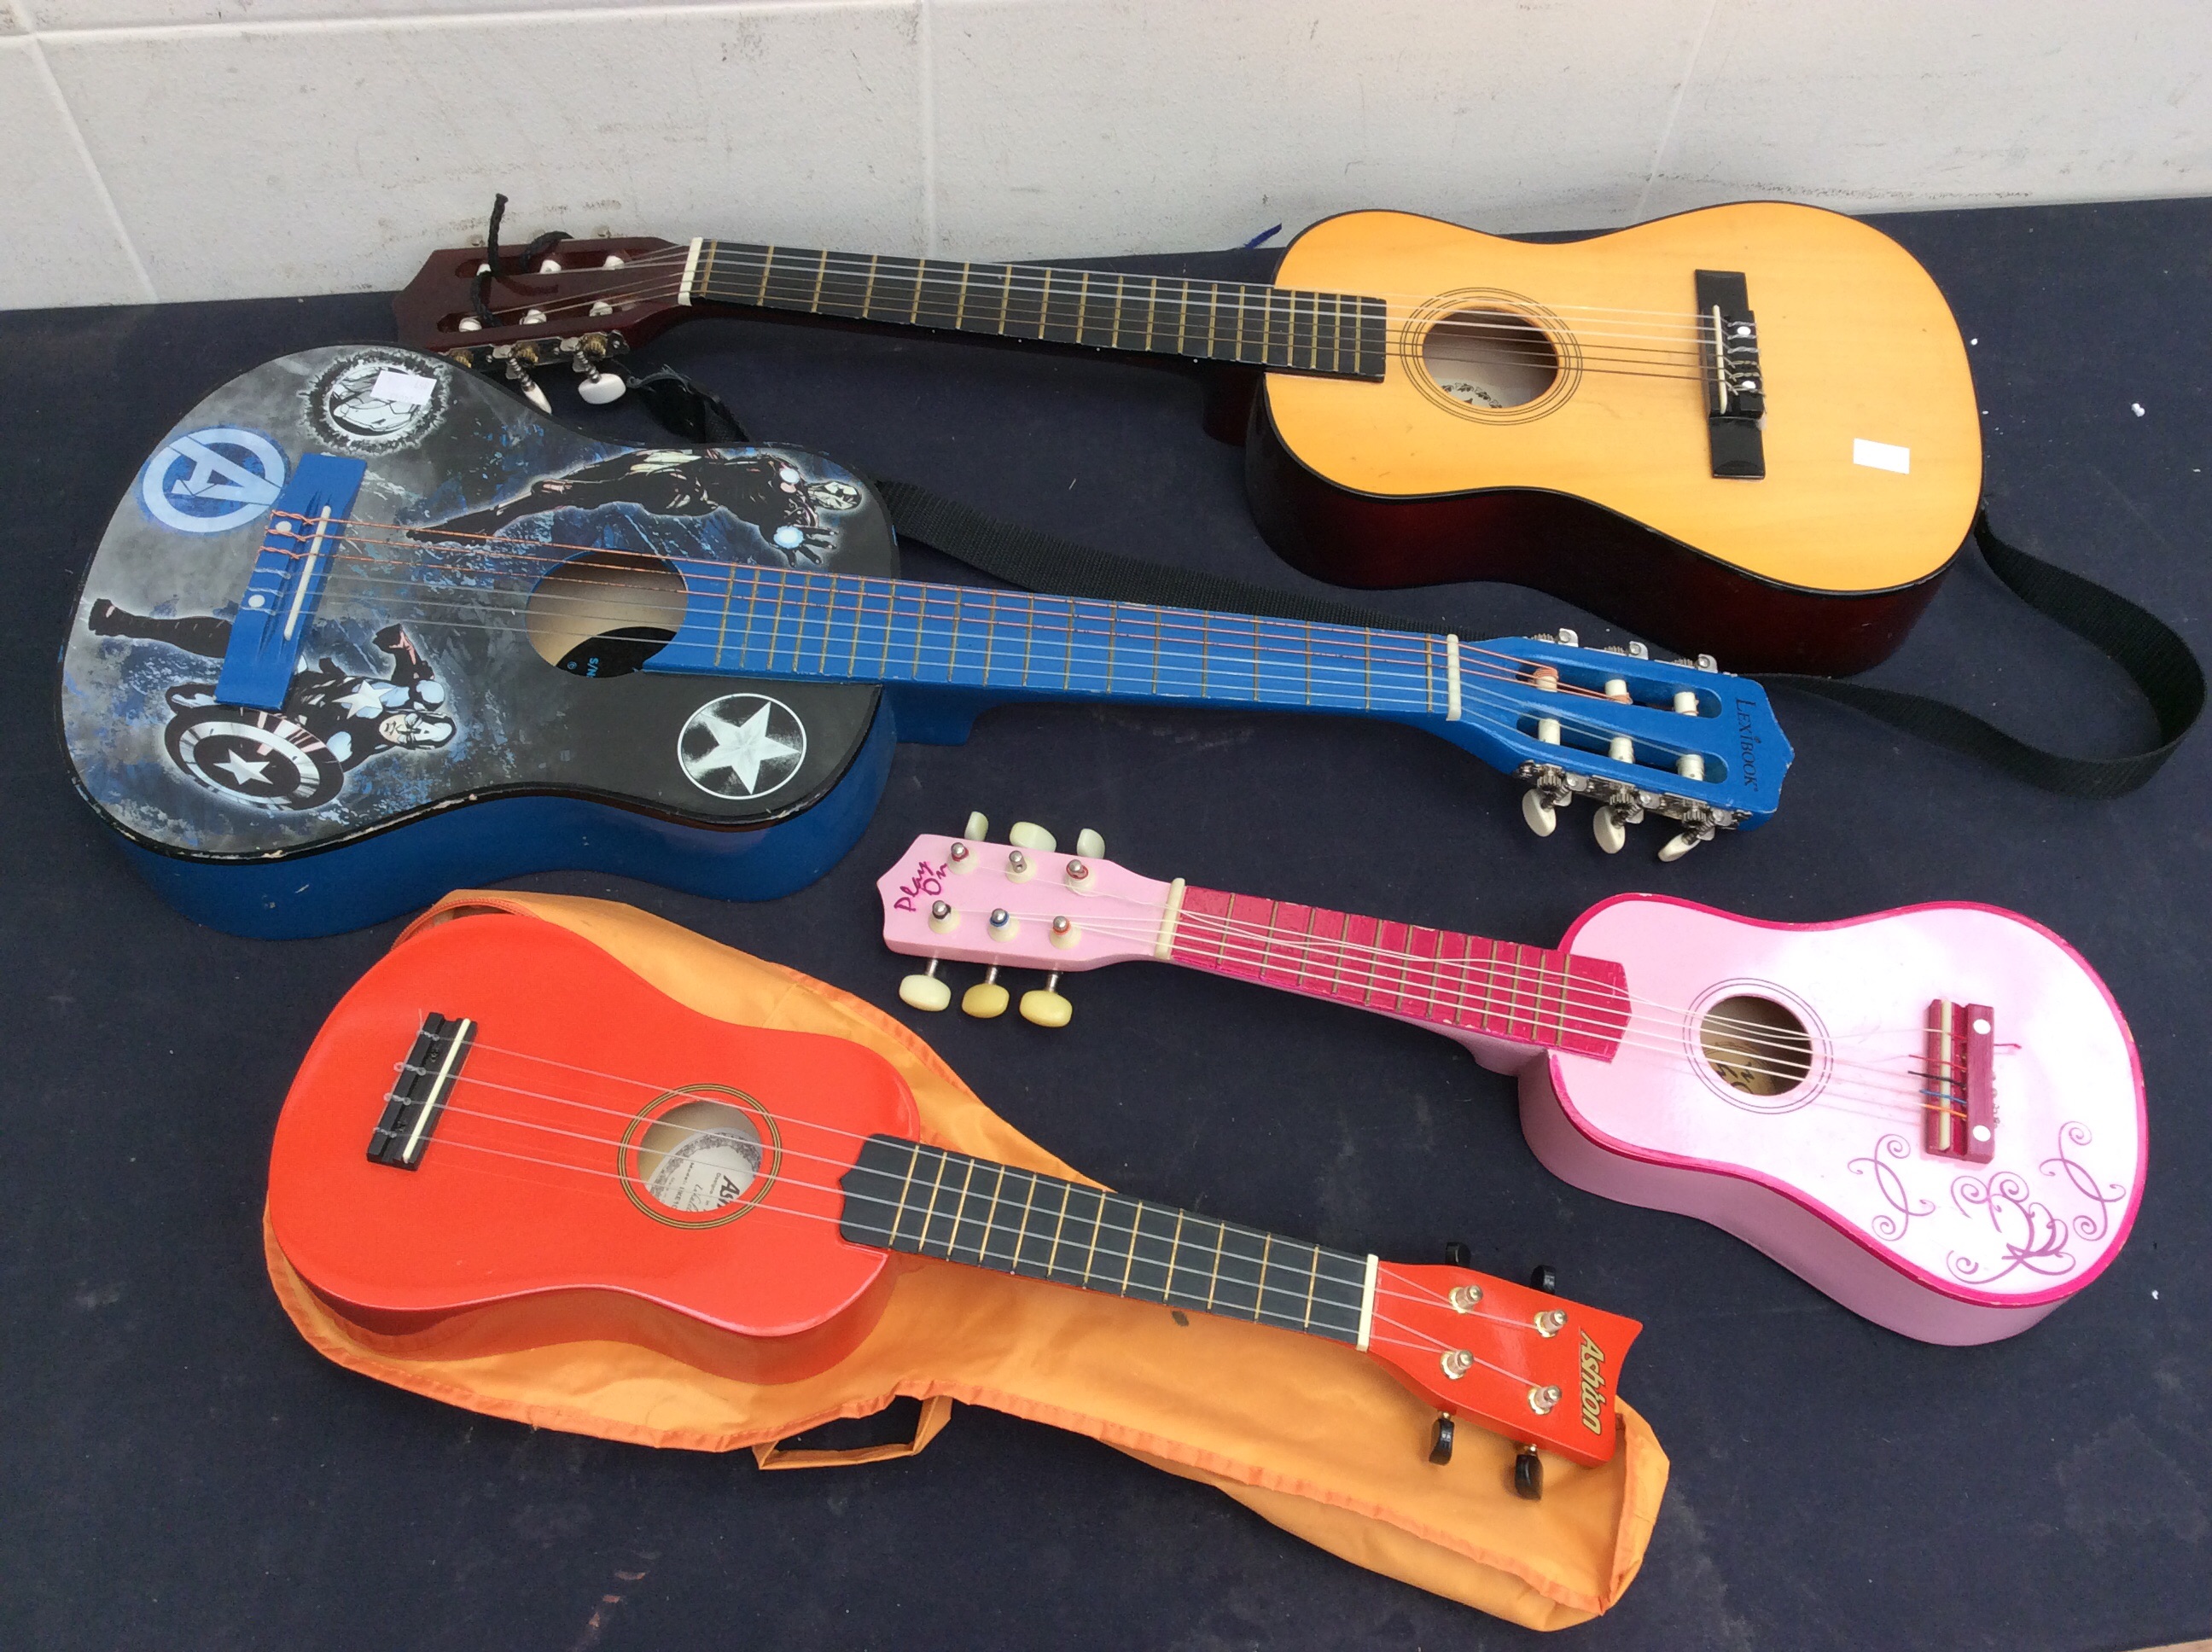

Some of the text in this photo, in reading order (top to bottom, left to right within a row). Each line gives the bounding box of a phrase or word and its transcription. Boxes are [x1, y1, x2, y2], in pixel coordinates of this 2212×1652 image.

[894, 861, 934, 912] Play
[922, 863, 948, 896] On
[1579, 1327, 1606, 1435] Ashton
